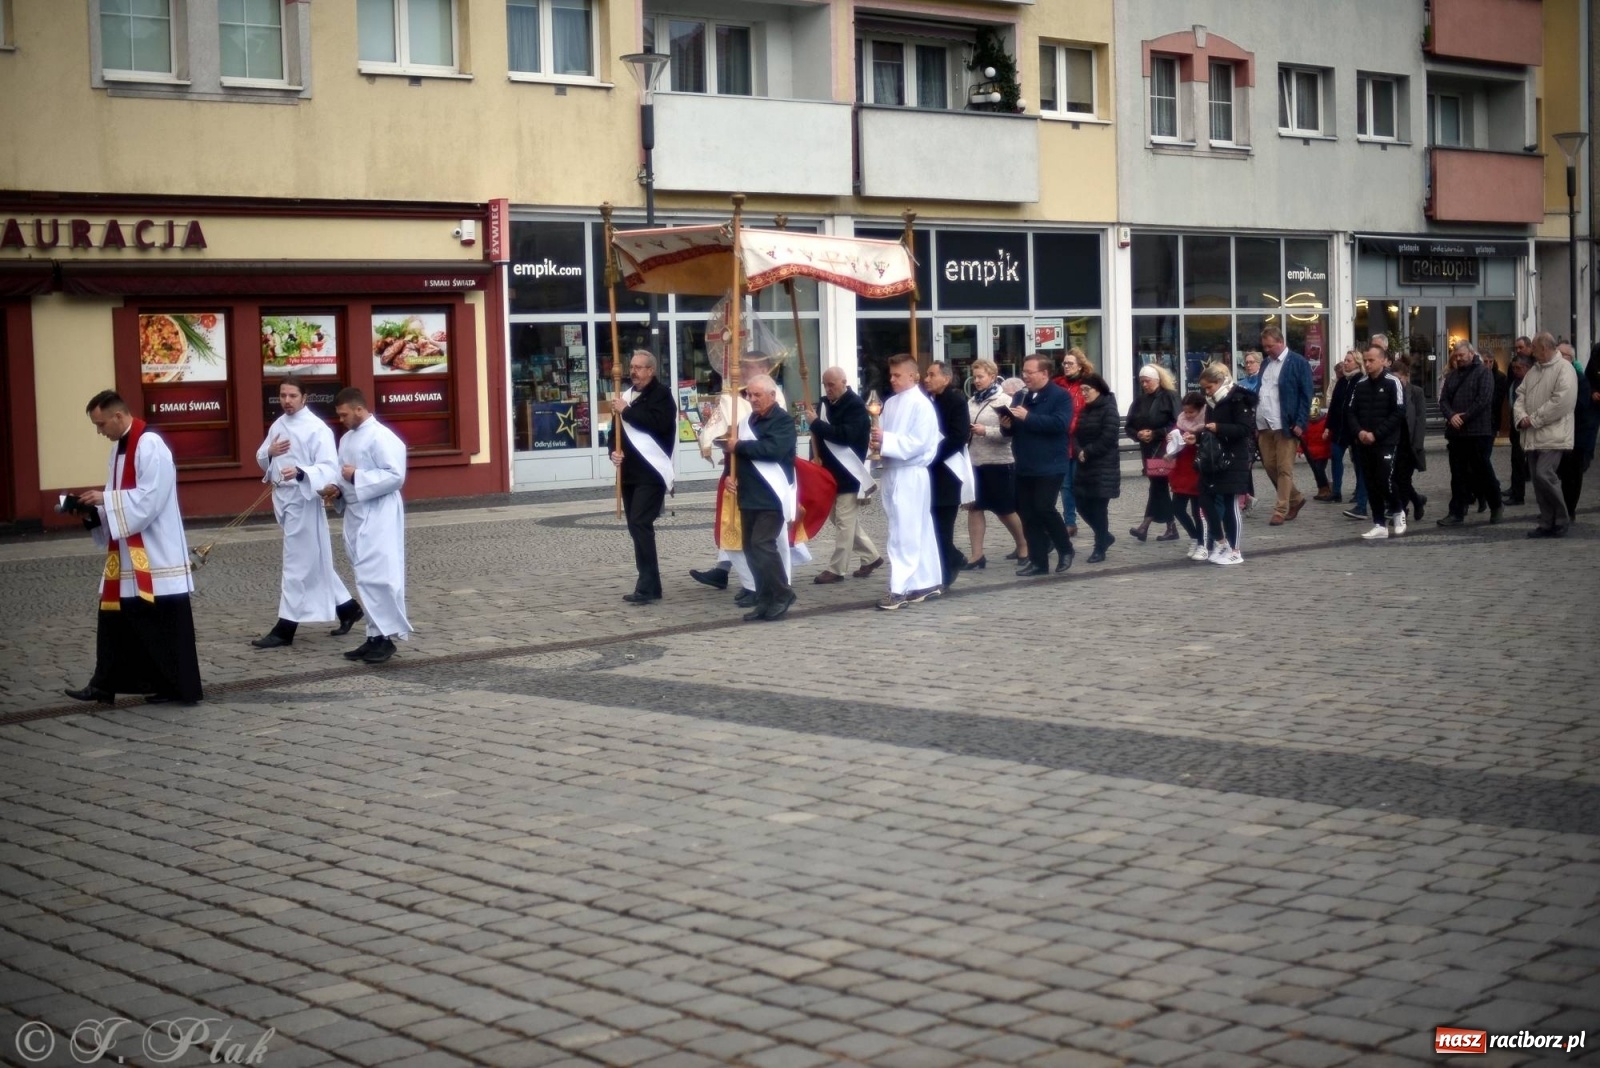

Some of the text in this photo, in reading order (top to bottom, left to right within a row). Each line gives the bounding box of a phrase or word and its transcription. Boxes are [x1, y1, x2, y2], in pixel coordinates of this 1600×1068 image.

[1, 218, 207, 249] AURACJA
[491, 204, 500, 256] ŻYWIEC
[513, 258, 582, 279] empik.com
[945, 249, 1020, 287] empik
[1287, 266, 1326, 282] empik.com
[429, 277, 476, 287] SMAKI ŚWIATA
[159, 400, 220, 412] SMAKI ŚWIATA
[388, 391, 443, 403] SMAKI ŚWIATA
